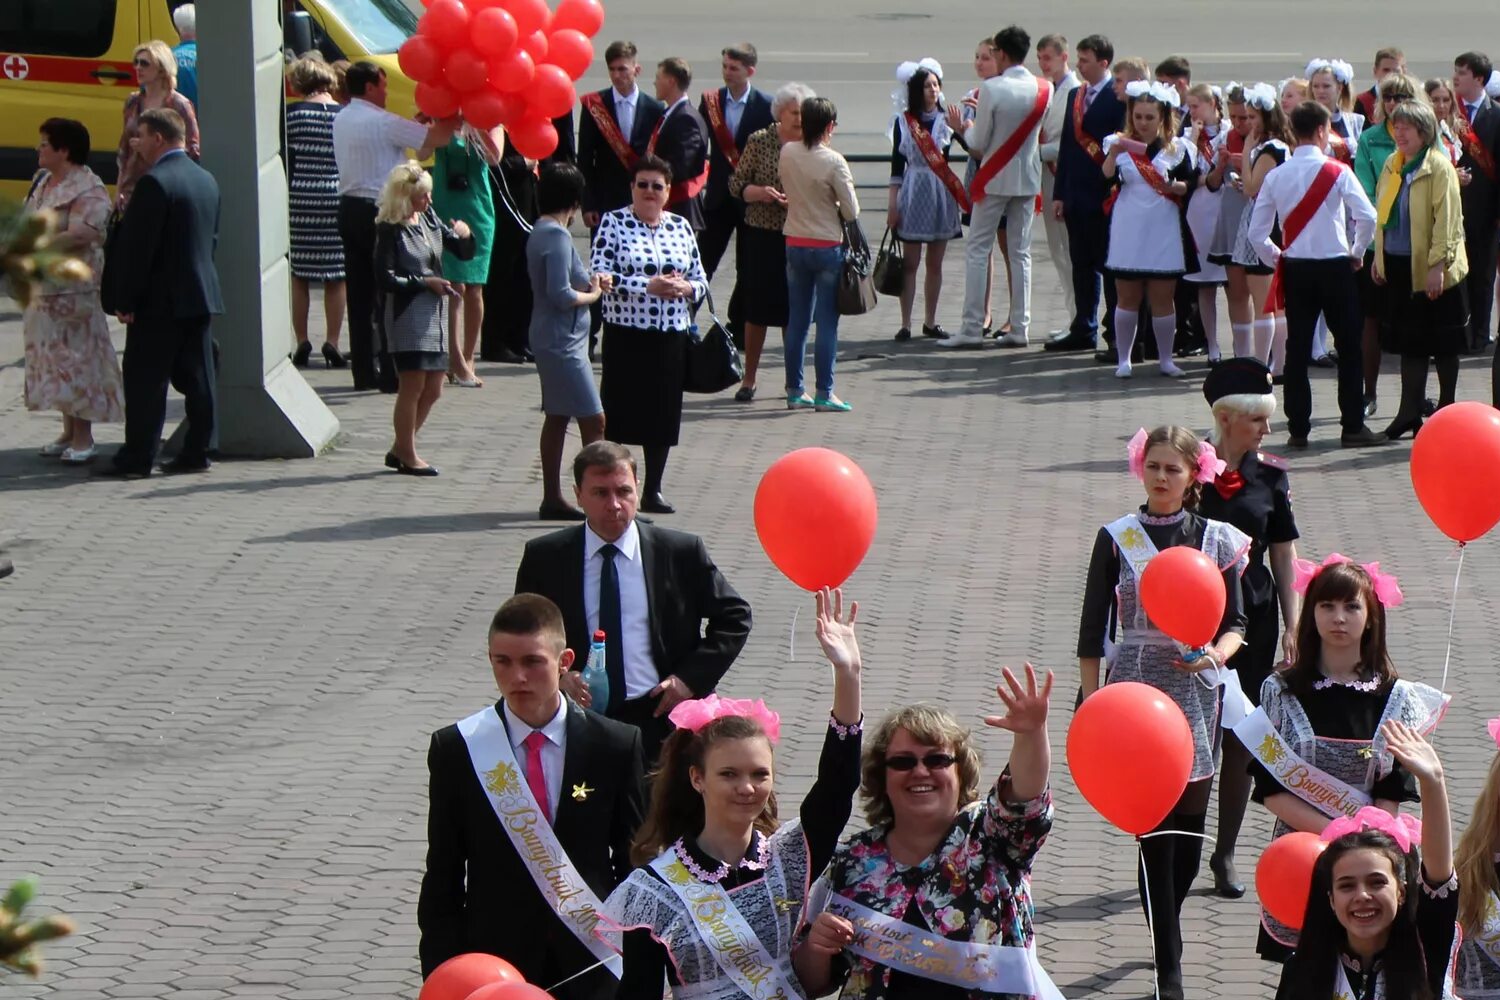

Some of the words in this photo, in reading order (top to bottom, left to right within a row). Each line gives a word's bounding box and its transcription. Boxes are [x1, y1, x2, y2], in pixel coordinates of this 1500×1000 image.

[1275, 758, 1362, 817] Выпускни
[499, 796, 584, 914] Выпускник
[685, 882, 774, 1000] Выпускник
